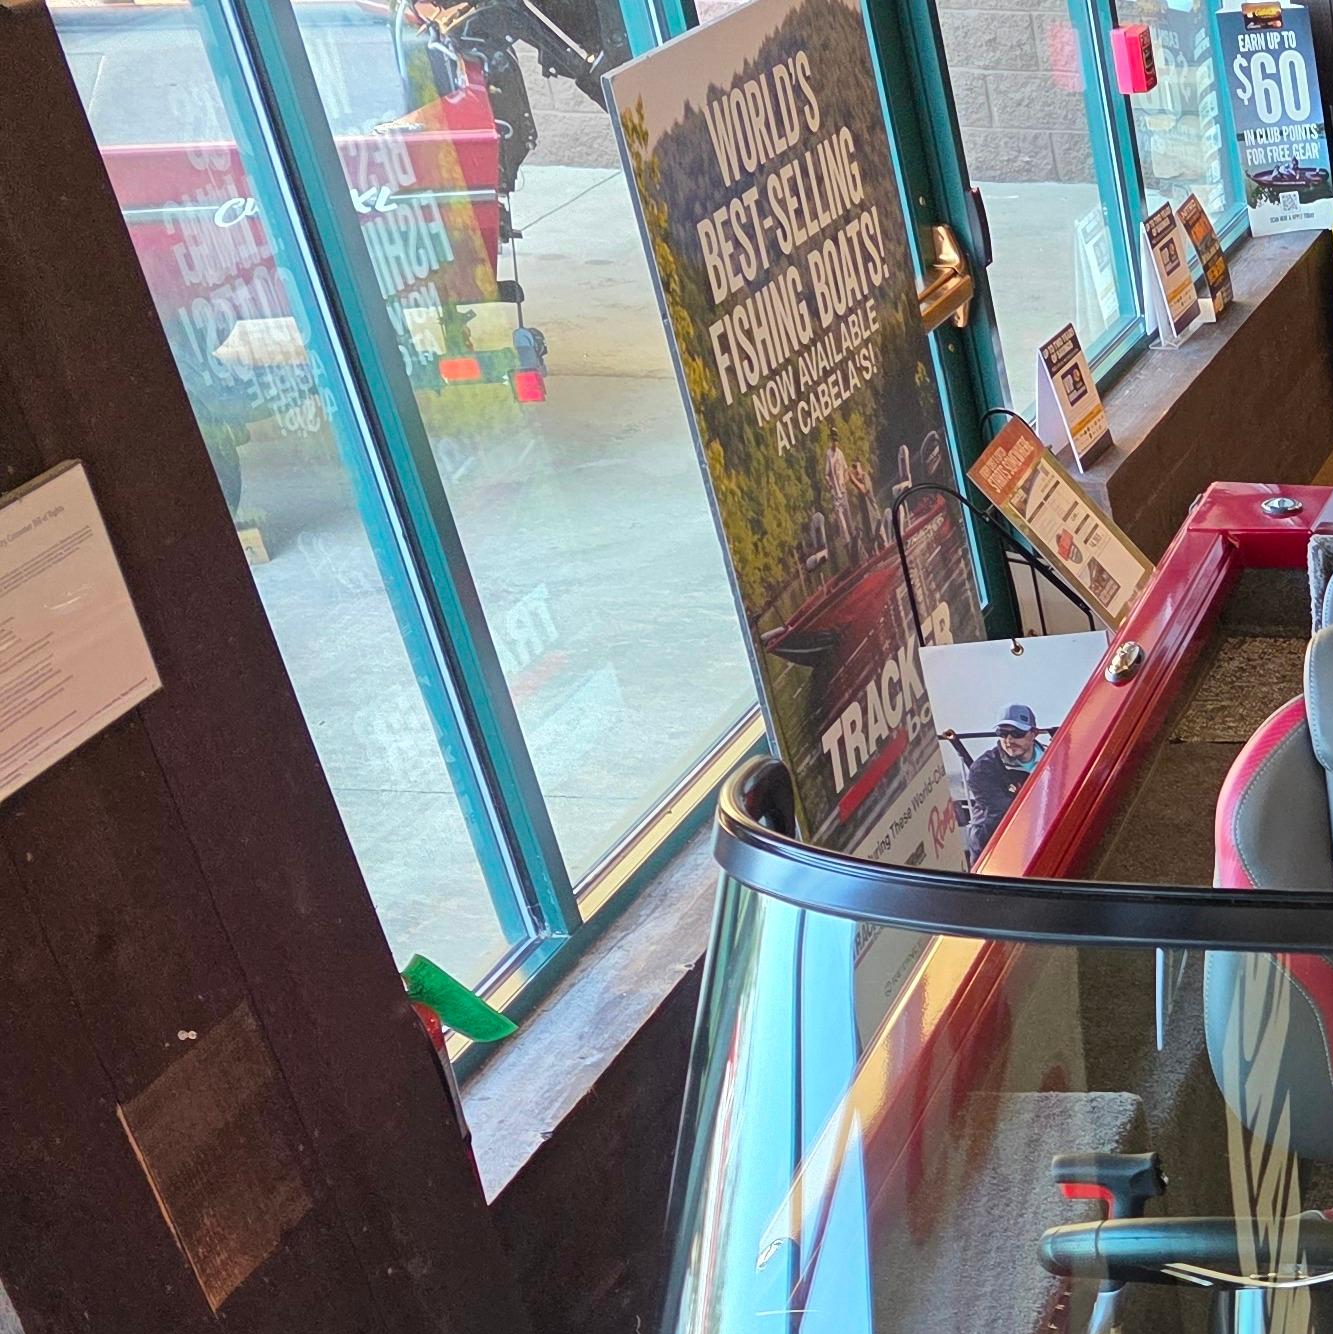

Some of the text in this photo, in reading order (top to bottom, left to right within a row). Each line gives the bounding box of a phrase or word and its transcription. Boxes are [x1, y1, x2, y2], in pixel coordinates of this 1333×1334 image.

[1233, 50, 1312, 124] $60
[1238, 31, 1297, 53] EARN UP TO
[703, 50, 820, 188] WORLD'S
[1244, 123, 1318, 147] IN CLUB POINTS
[1247, 147, 1266, 166] FOR
[1266, 144, 1291, 163] FREE
[697, 126, 863, 304] BEST-SELLING
[709, 207, 890, 405] FISHING BOATS!
[752, 298, 880, 427] NOW AVAILABLE
[775, 348, 878, 455] AT CABELA'S!
[888, 808, 913, 840] These
[912, 764, 946, 815] World-Cla
